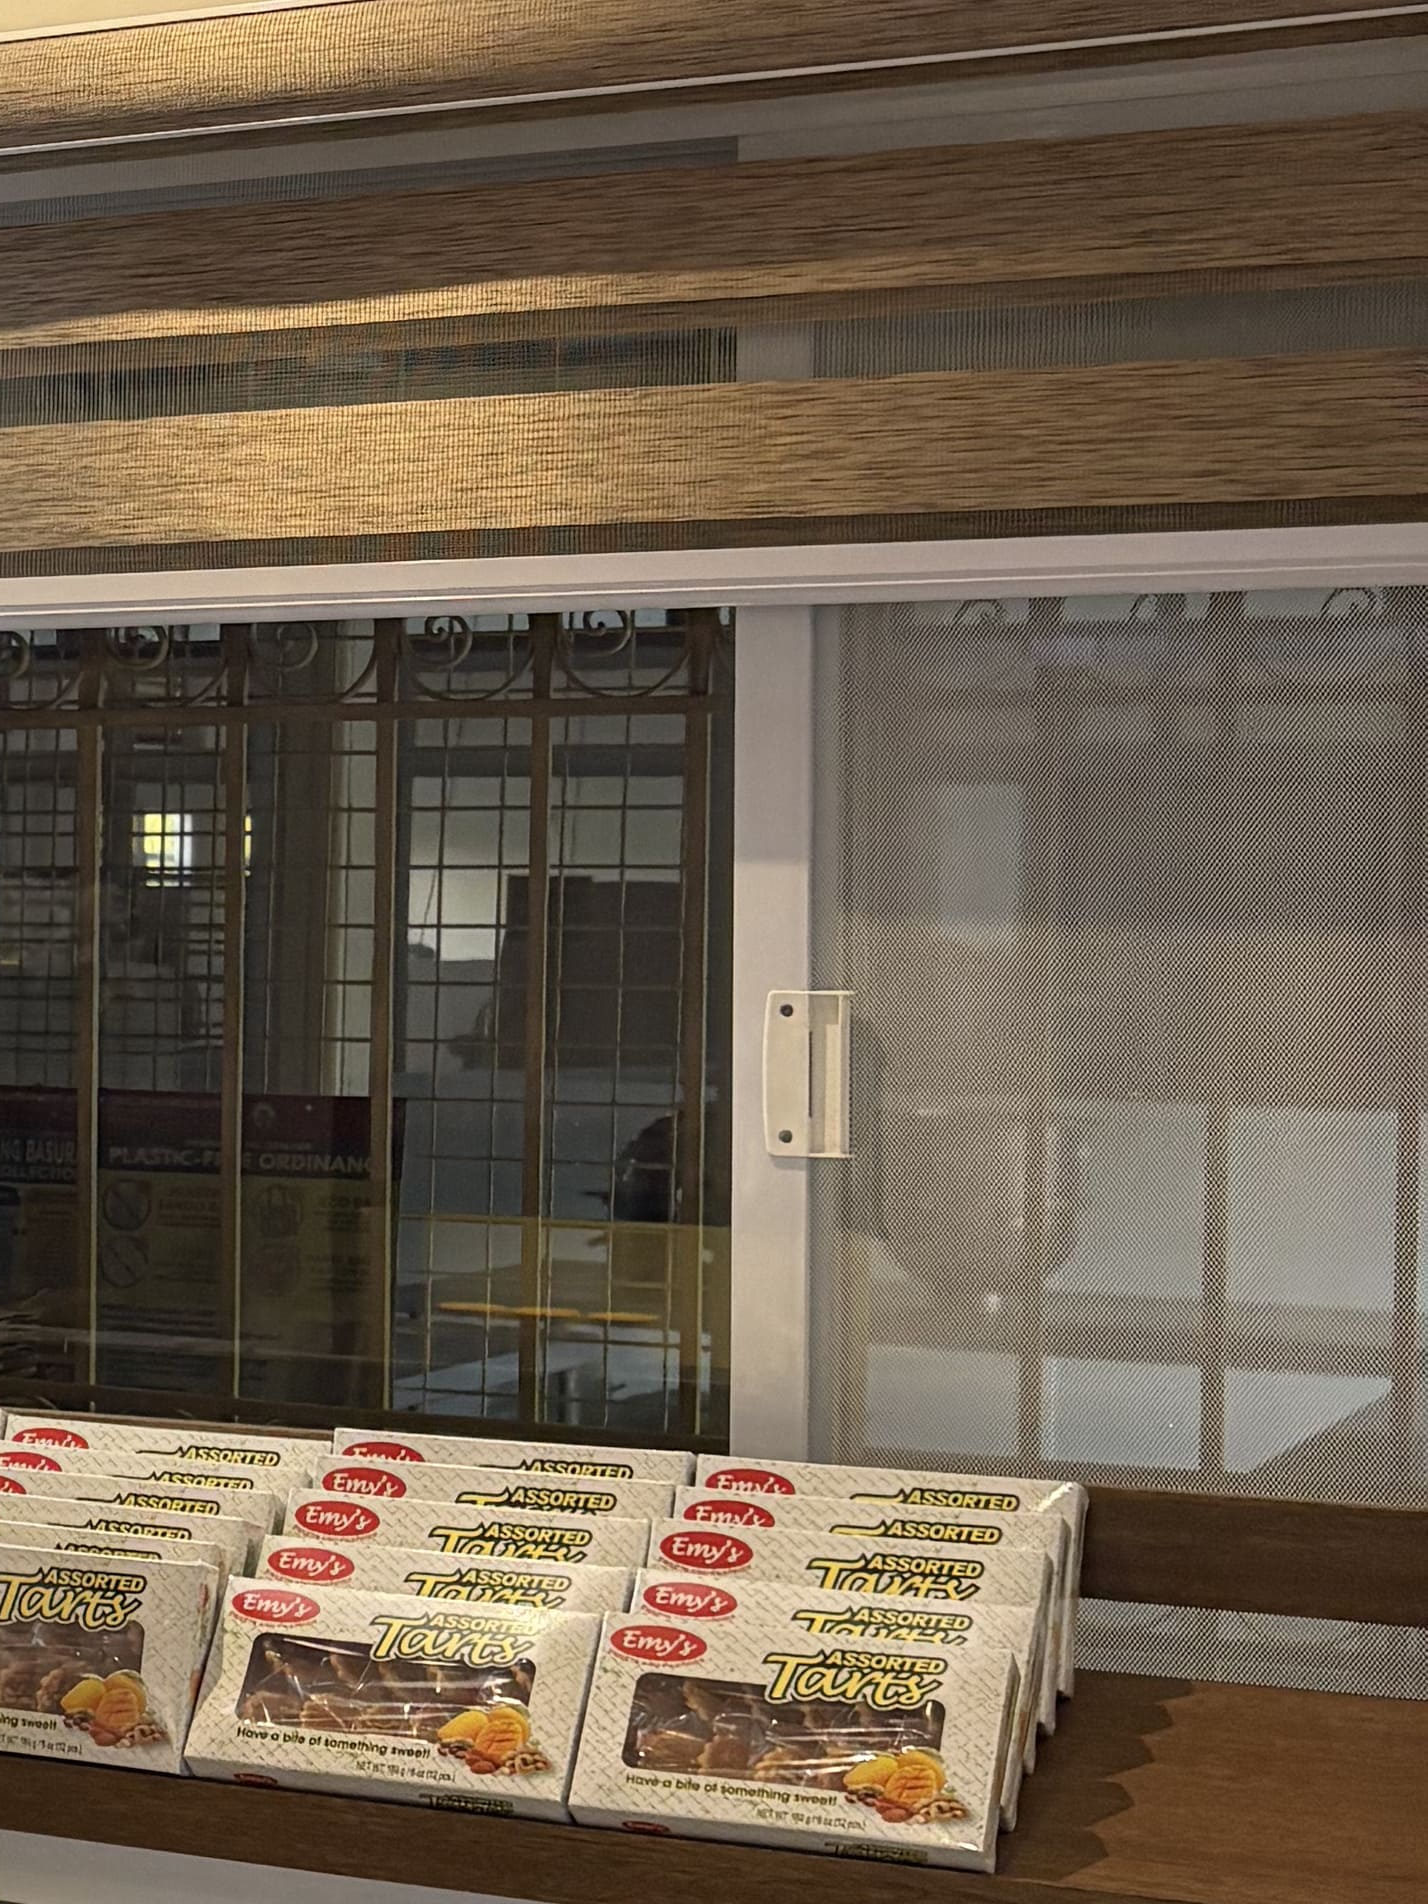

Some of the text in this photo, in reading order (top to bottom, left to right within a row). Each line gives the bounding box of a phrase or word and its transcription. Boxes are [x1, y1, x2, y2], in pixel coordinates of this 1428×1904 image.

[109, 1146, 251, 1169] PLASTIC-FE
[187, 1446, 279, 1466] ASSORTED
[160, 1471, 252, 1490] ASSORTED
[333, 1472, 397, 1497] Emy's
[126, 1493, 219, 1516] ASSORTED
[511, 1488, 616, 1511] ASSORTED
[907, 1489, 1018, 1512] ASSORTED
[306, 1506, 371, 1533] Emy's
[695, 1505, 766, 1527] Emy's
[487, 1523, 592, 1547] ASSORTED
[888, 1521, 1001, 1544] ASSORTED
[671, 1537, 743, 1564] Emy's
[279, 1553, 346, 1578] Emy's
[868, 1555, 984, 1578] ASSORTED
[45, 1568, 146, 1593] ASSORTED
[463, 1569, 570, 1591] ASSORTED
[244, 1592, 309, 1618] Emy's
[654, 1588, 727, 1613] Emy's
[431, 1612, 539, 1636] ASSORTED
[855, 1607, 971, 1631] ASSORTED
[372, 1615, 532, 1666] Tarts
[622, 1629, 697, 1658] Emy's
[828, 1651, 947, 1675] ASSORTED
[764, 1655, 942, 1709] Tarts
[236, 1726, 267, 1742] Have
[283, 1731, 305, 1745] bite
[325, 1737, 388, 1756] something
[625, 1773, 659, 1787] Have
[676, 1778, 700, 1792] bite
[720, 1783, 790, 1804] something
